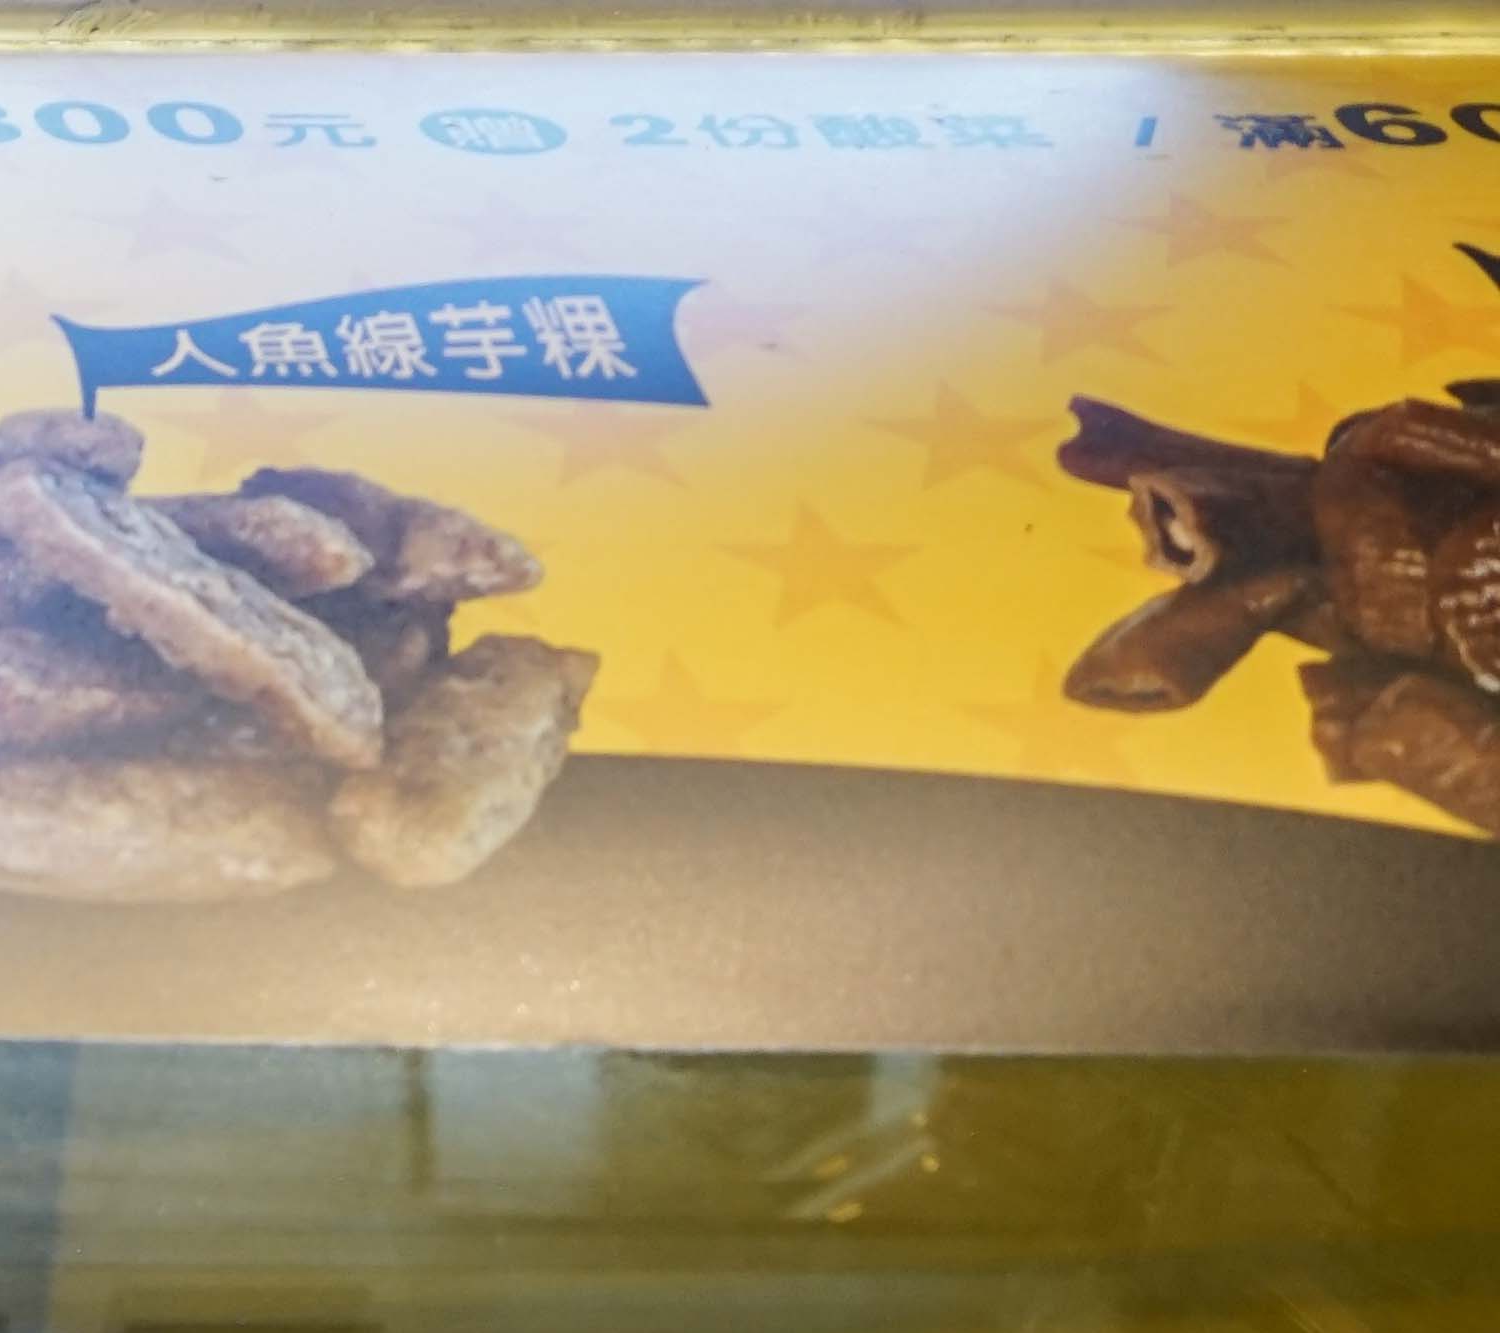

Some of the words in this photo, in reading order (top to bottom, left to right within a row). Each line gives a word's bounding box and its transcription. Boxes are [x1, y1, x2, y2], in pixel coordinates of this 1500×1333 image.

[150, 293, 640, 381] 人魚線芋粿
